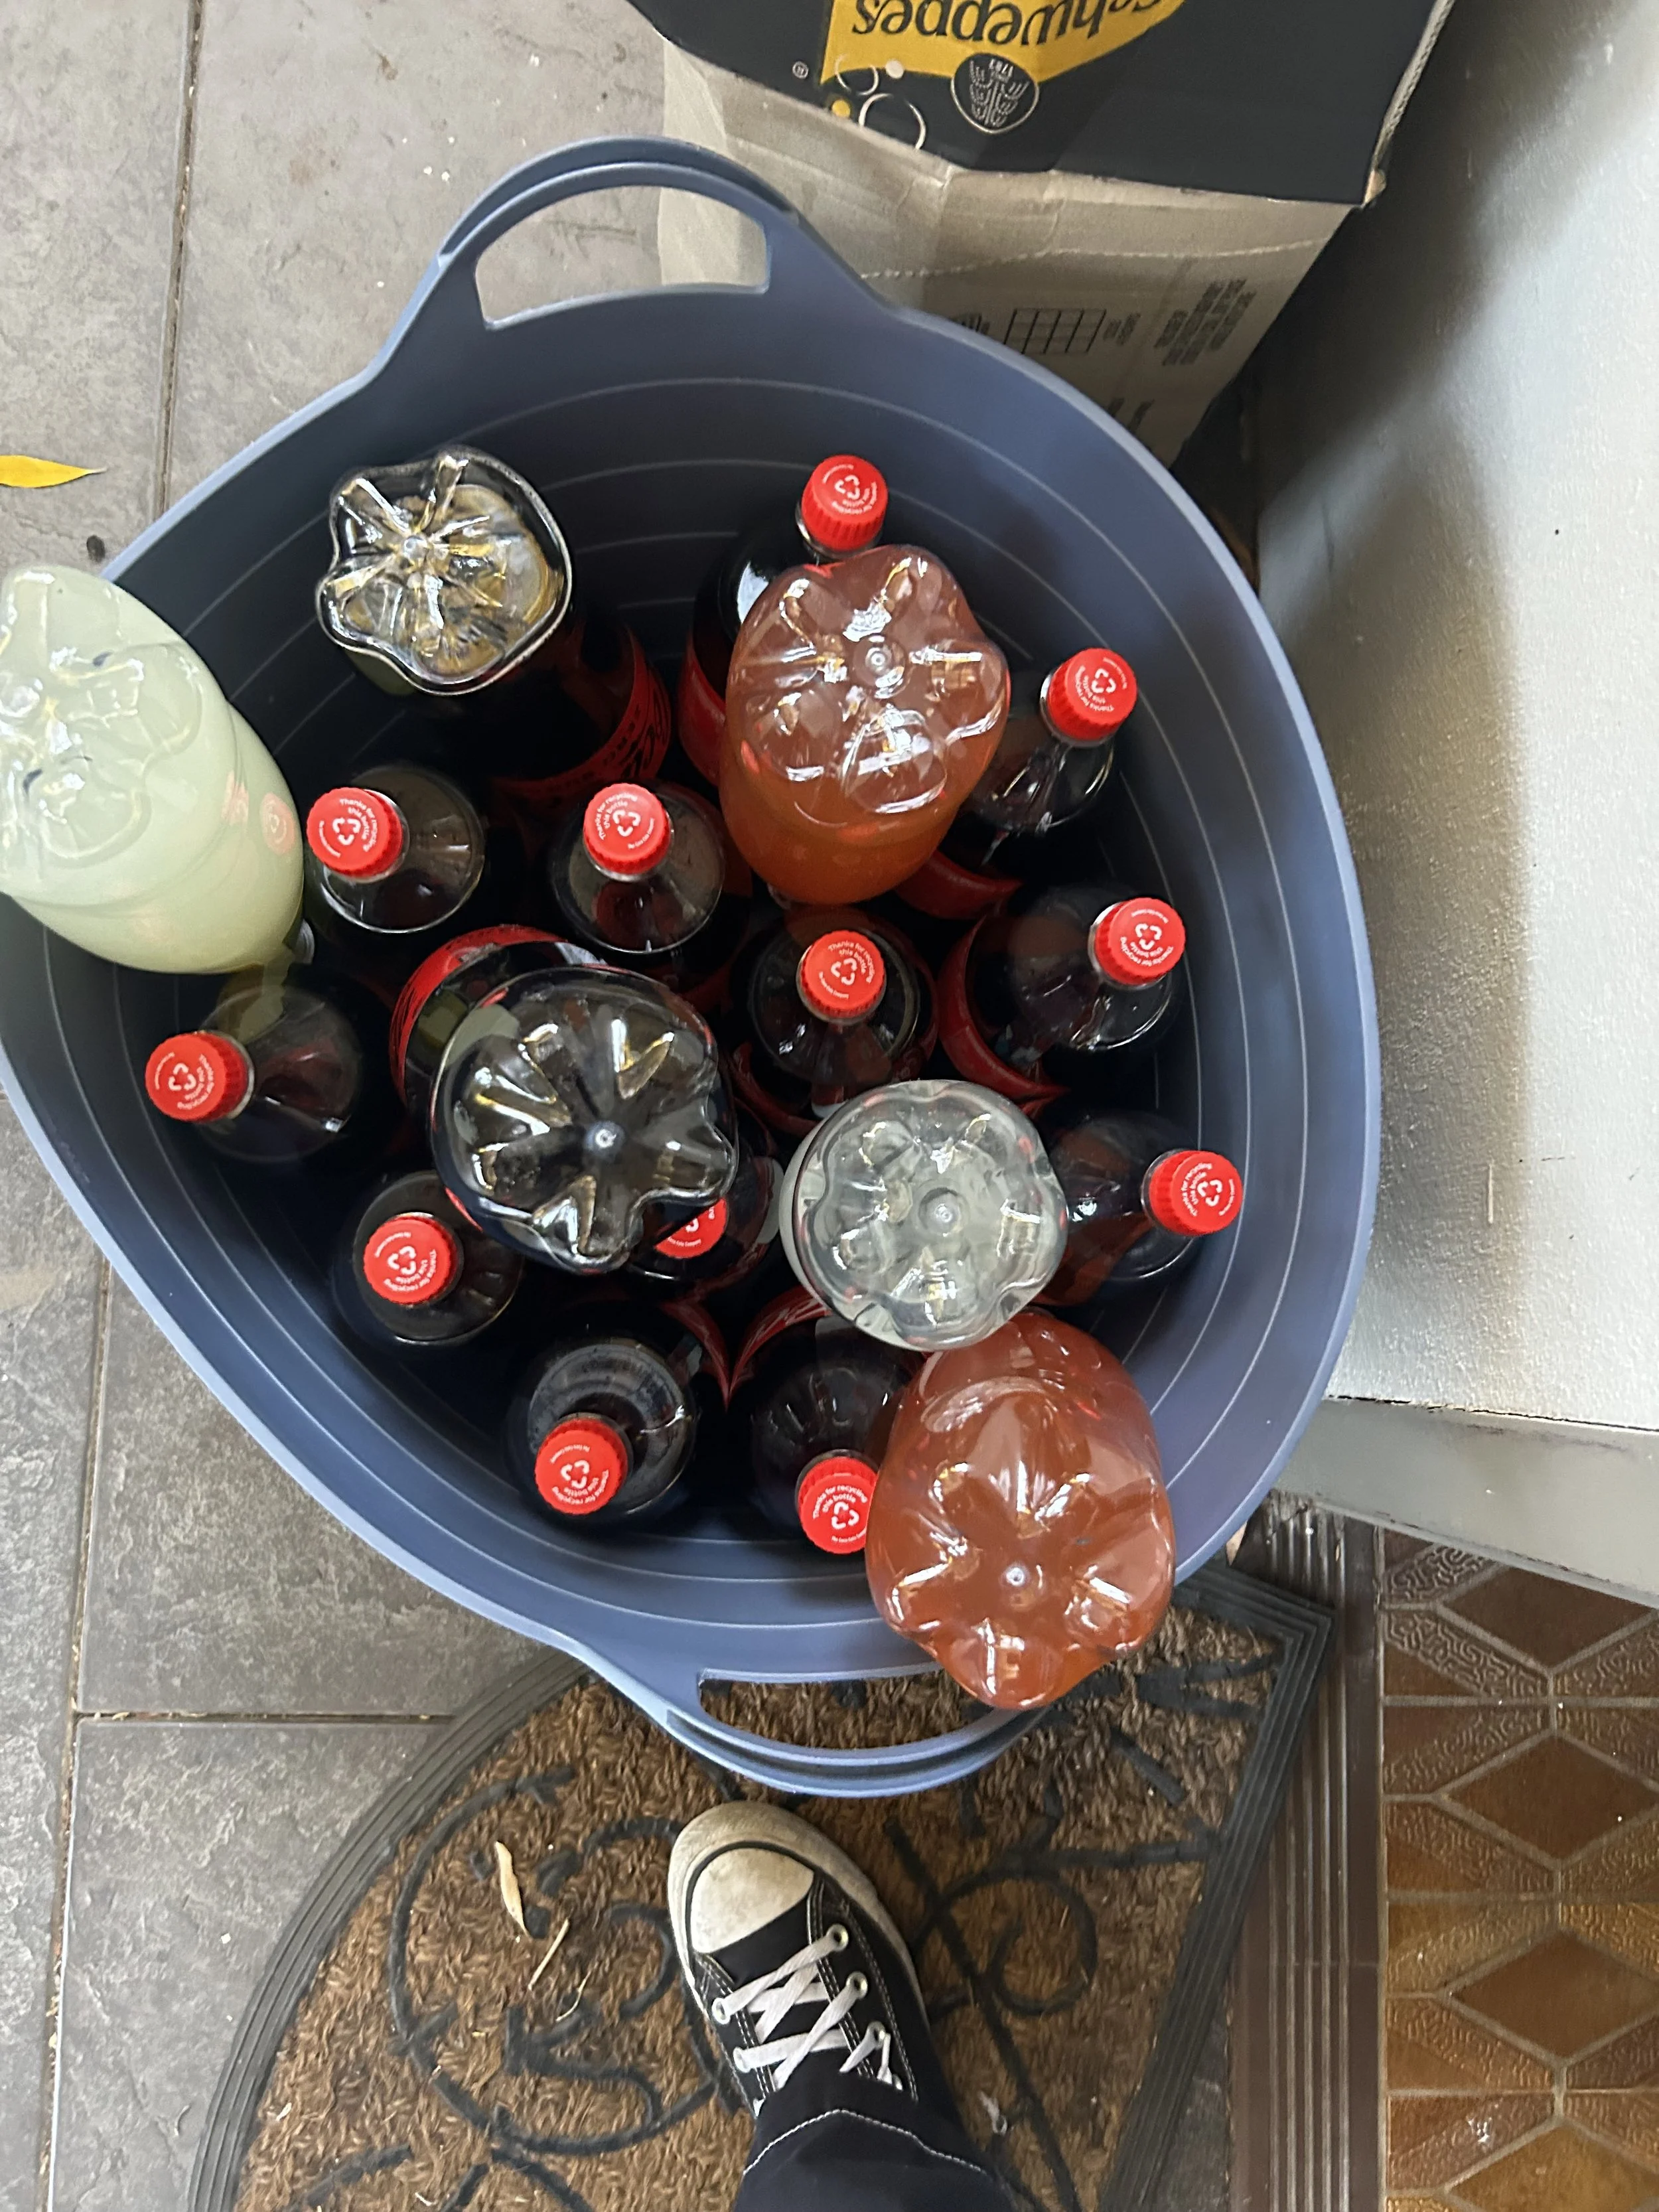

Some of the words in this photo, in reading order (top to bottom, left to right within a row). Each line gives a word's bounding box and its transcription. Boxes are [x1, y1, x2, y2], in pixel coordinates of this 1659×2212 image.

[605, 793, 638, 804] recycling
[339, 798, 366, 810] Thanks
[366, 808, 376, 819] for
[597, 802, 606, 813] for
[605, 800, 628, 815] bottle
[595, 813, 606, 840] Thanks
[828, 940, 855, 952] Thanks
[855, 942, 865, 954] for
[863, 950, 875, 984] recycling
[853, 952, 867, 974] bottle
[1152, 946, 1174, 965] Thanks
[1185, 1163, 1213, 1181] recycling
[1189, 1172, 1207, 1189] bottle
[1182, 1193, 1198, 1217] Thanks
[1190, 1190, 1199, 1205] this
[418, 1259, 428, 1275] this
[427, 1249, 437, 1278] Thanks
[384, 1278, 419, 1292] recycling
[396, 1273, 421, 1285] bottle
[419, 1278, 431, 1288] for
[587, 1477, 599, 1491] this
[595, 1469, 609, 1497] Thanks
[552, 1486, 584, 1505] recycling
[563, 1487, 589, 1498] bottle
[585, 1495, 596, 1504] for
[812, 1493, 827, 1519] Thanks
[836, 1485, 868, 1503] recycling
[822, 1499, 833, 1513] this
[833, 1493, 856, 1503] bottle
